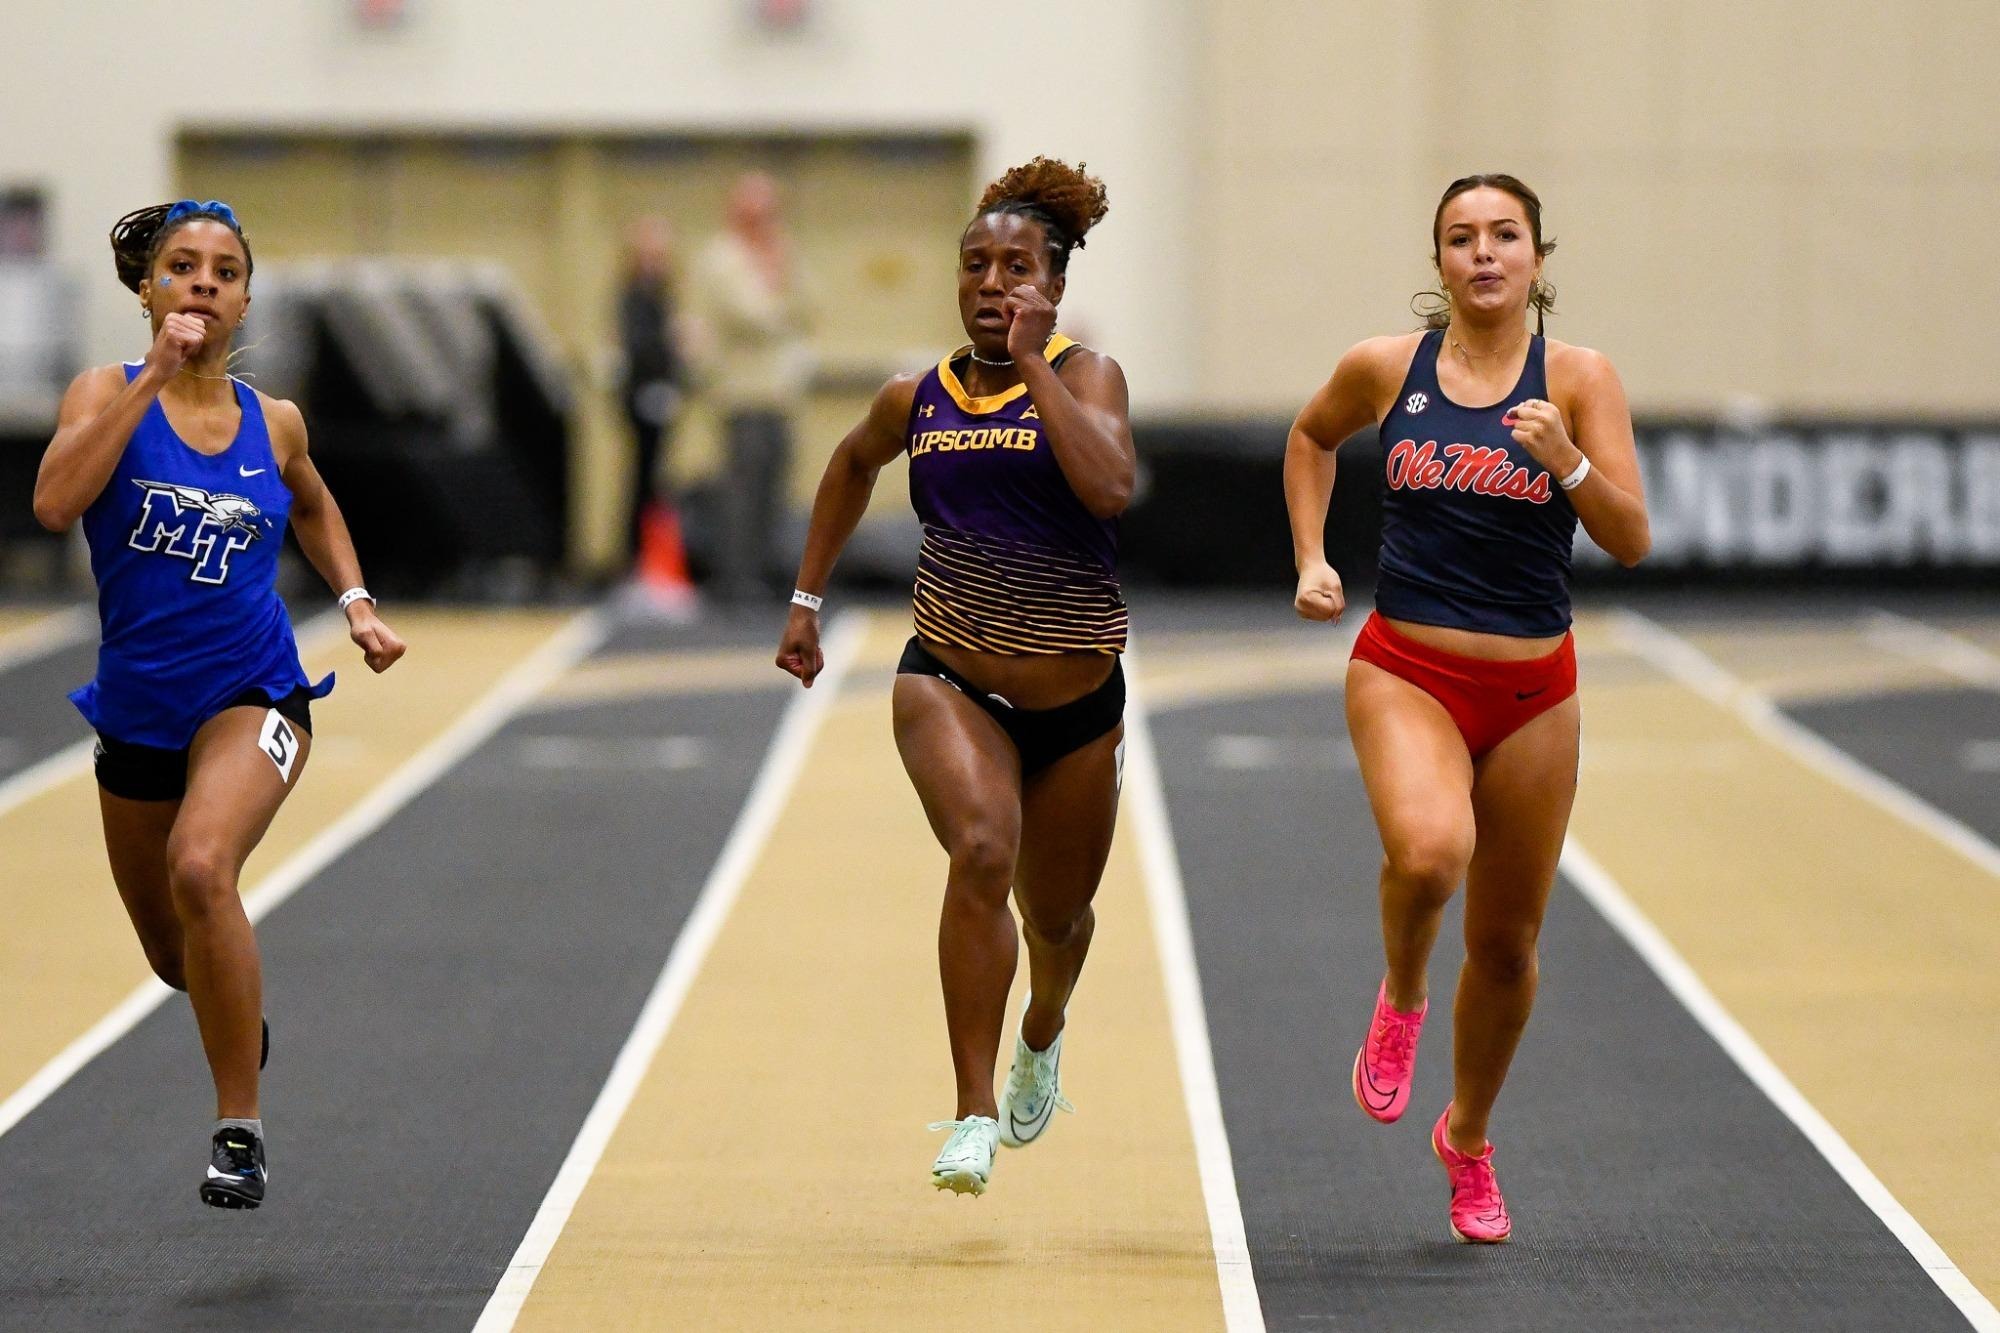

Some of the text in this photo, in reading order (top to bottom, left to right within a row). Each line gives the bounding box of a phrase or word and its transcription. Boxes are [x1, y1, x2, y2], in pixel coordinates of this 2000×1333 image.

[1406, 393, 1428, 413] SEC
[911, 428, 1038, 458] LIPSCOMB
[1386, 439, 1553, 504] Ole Miss
[128, 488, 252, 584] MT
[268, 719, 293, 767] 5
